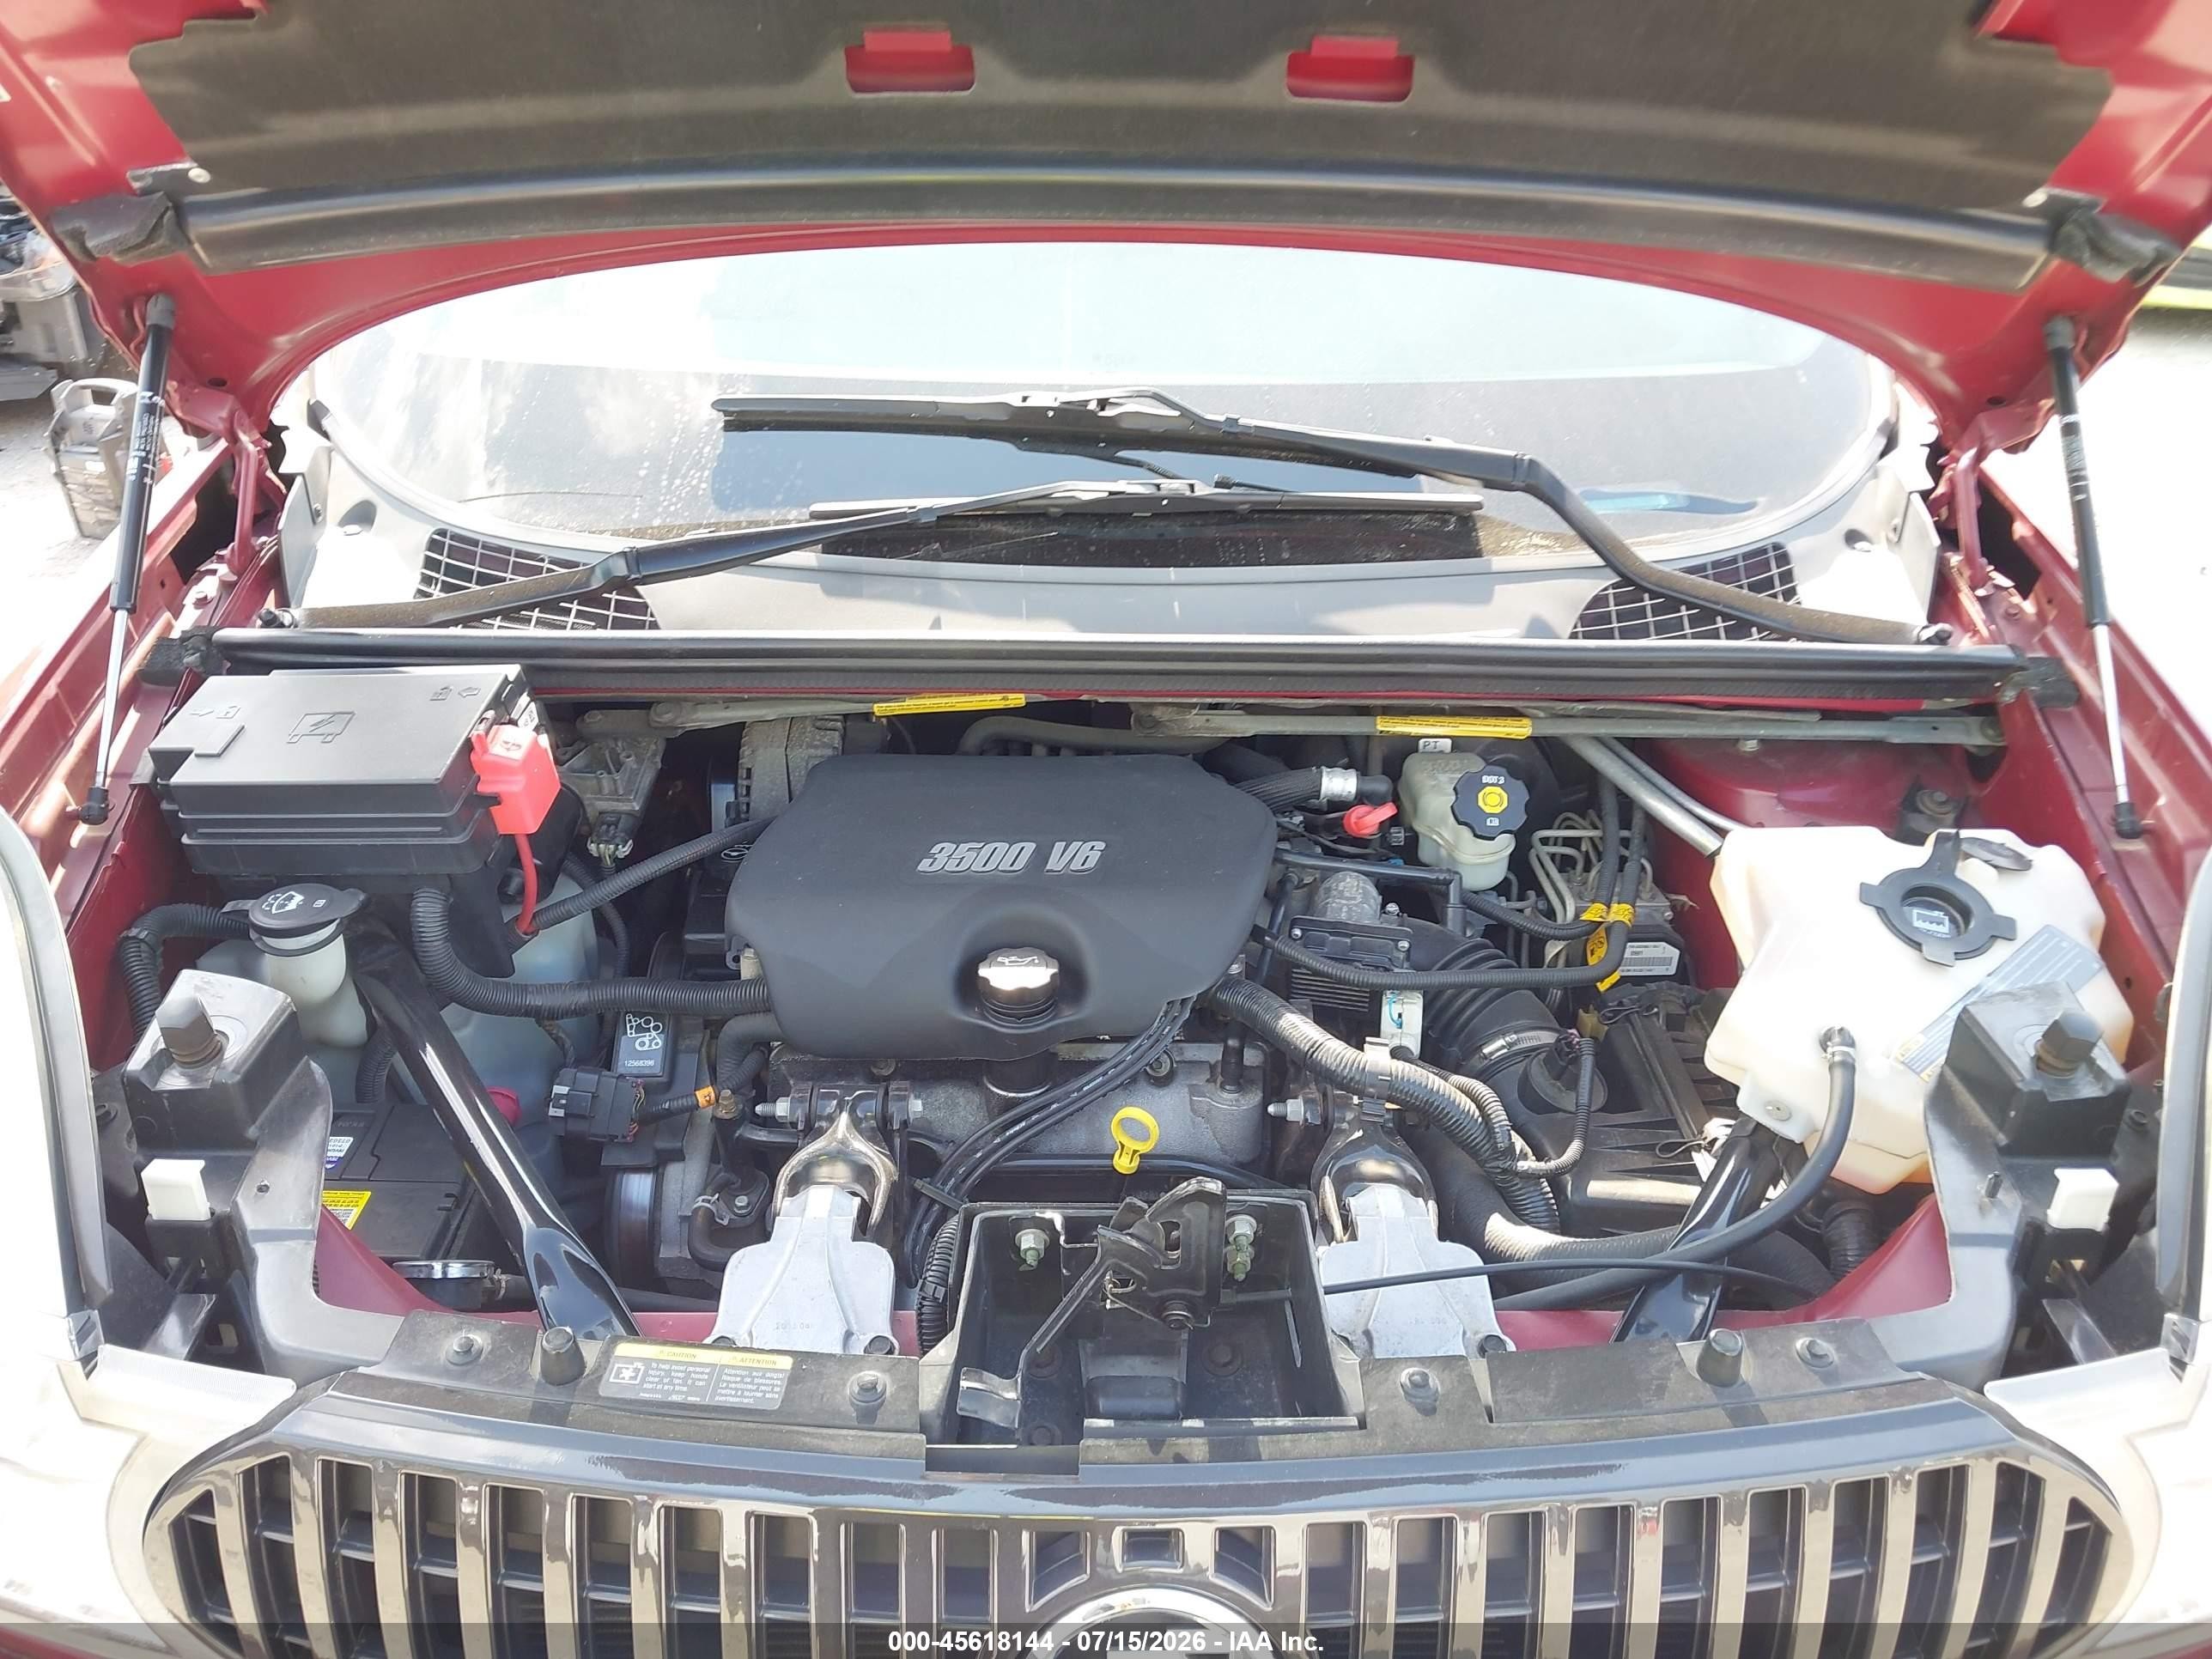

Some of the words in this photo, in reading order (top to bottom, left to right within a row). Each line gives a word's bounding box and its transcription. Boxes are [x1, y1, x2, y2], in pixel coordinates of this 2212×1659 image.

[1422, 740, 1440, 750] PT
[916, 841, 1037, 873] 3500
[1043, 841, 1107, 874] V6
